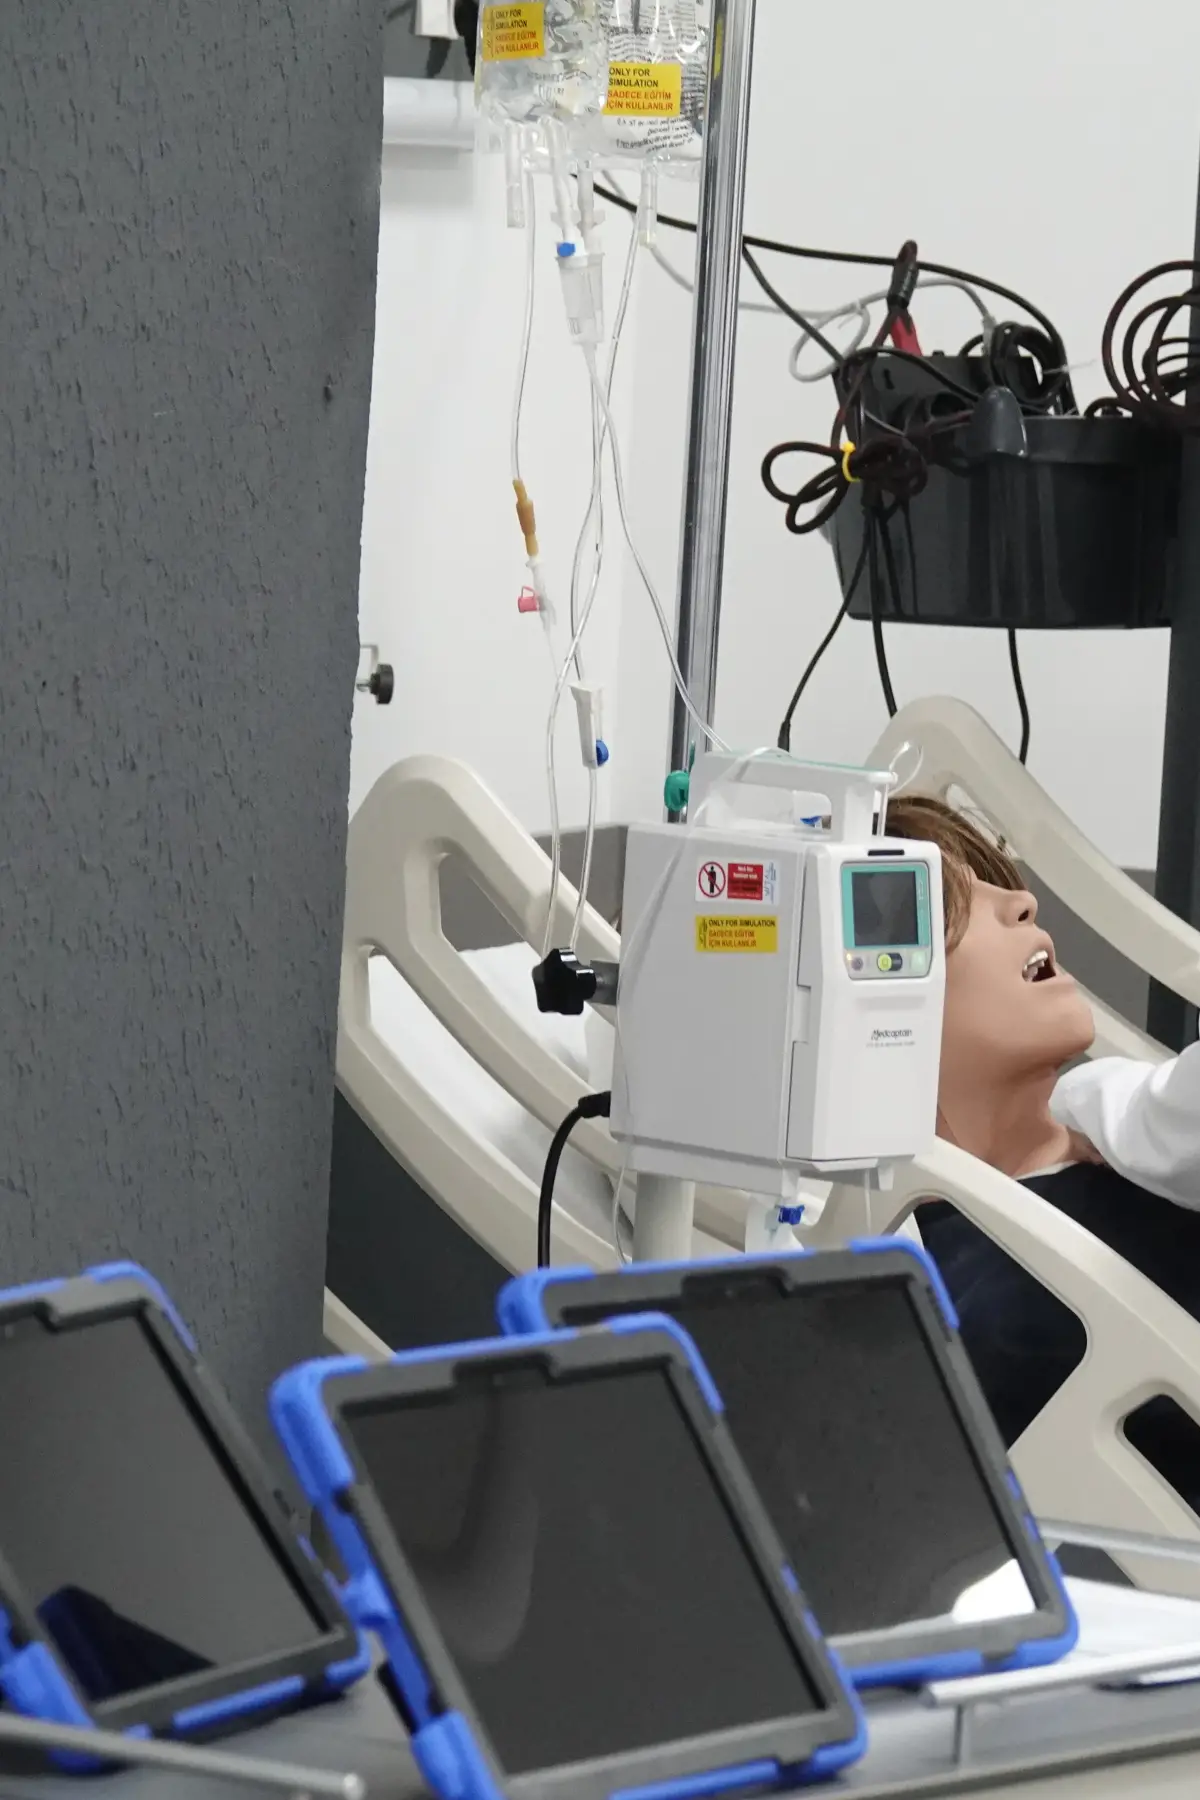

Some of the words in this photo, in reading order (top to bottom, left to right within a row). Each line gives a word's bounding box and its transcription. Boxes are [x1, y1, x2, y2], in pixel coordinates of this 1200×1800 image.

[495, 10, 509, 19] ONLY
[509, 9, 522, 18] FOR
[495, 20, 528, 30] SIMULATION
[609, 67, 631, 77] ONLY
[633, 68, 650, 77] FOR
[608, 79, 658, 88] SIMULATION
[608, 89, 641, 99] SADECE
[644, 91, 671, 101] EĞİTİM
[625, 101, 673, 111] KULLANILIR
[708, 918, 724, 928] ONLY
[725, 919, 738, 927] FOR
[739, 919, 776, 928] SIMULATION
